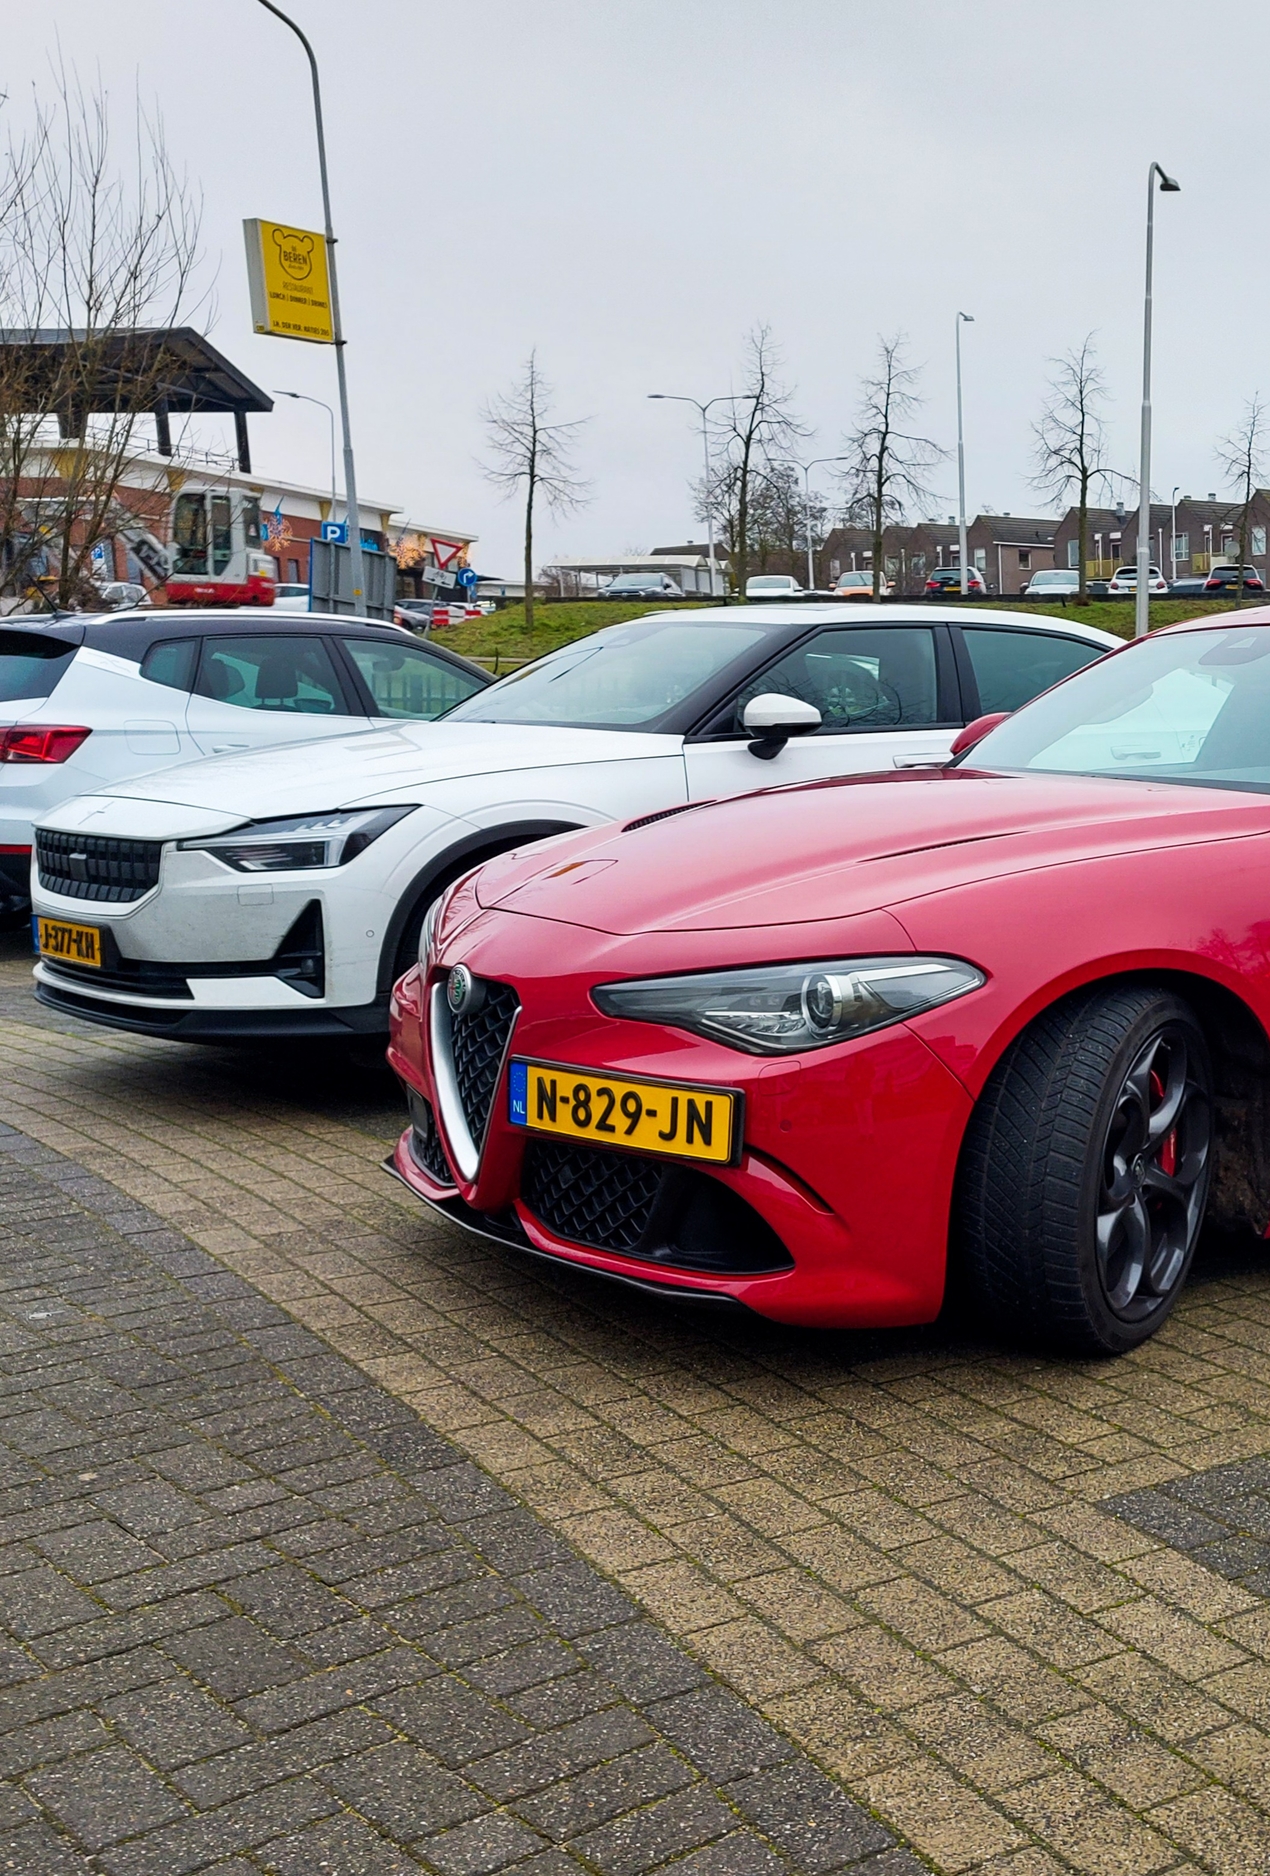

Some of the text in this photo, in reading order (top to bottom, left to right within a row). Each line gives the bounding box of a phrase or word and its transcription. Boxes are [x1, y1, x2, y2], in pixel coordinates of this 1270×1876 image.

[283, 250, 308, 265] BEREN
[327, 525, 341, 541] P
[42, 923, 96, 960] J-377-KH
[512, 1099, 526, 1115] NL
[536, 1076, 714, 1147] N-829-JN
